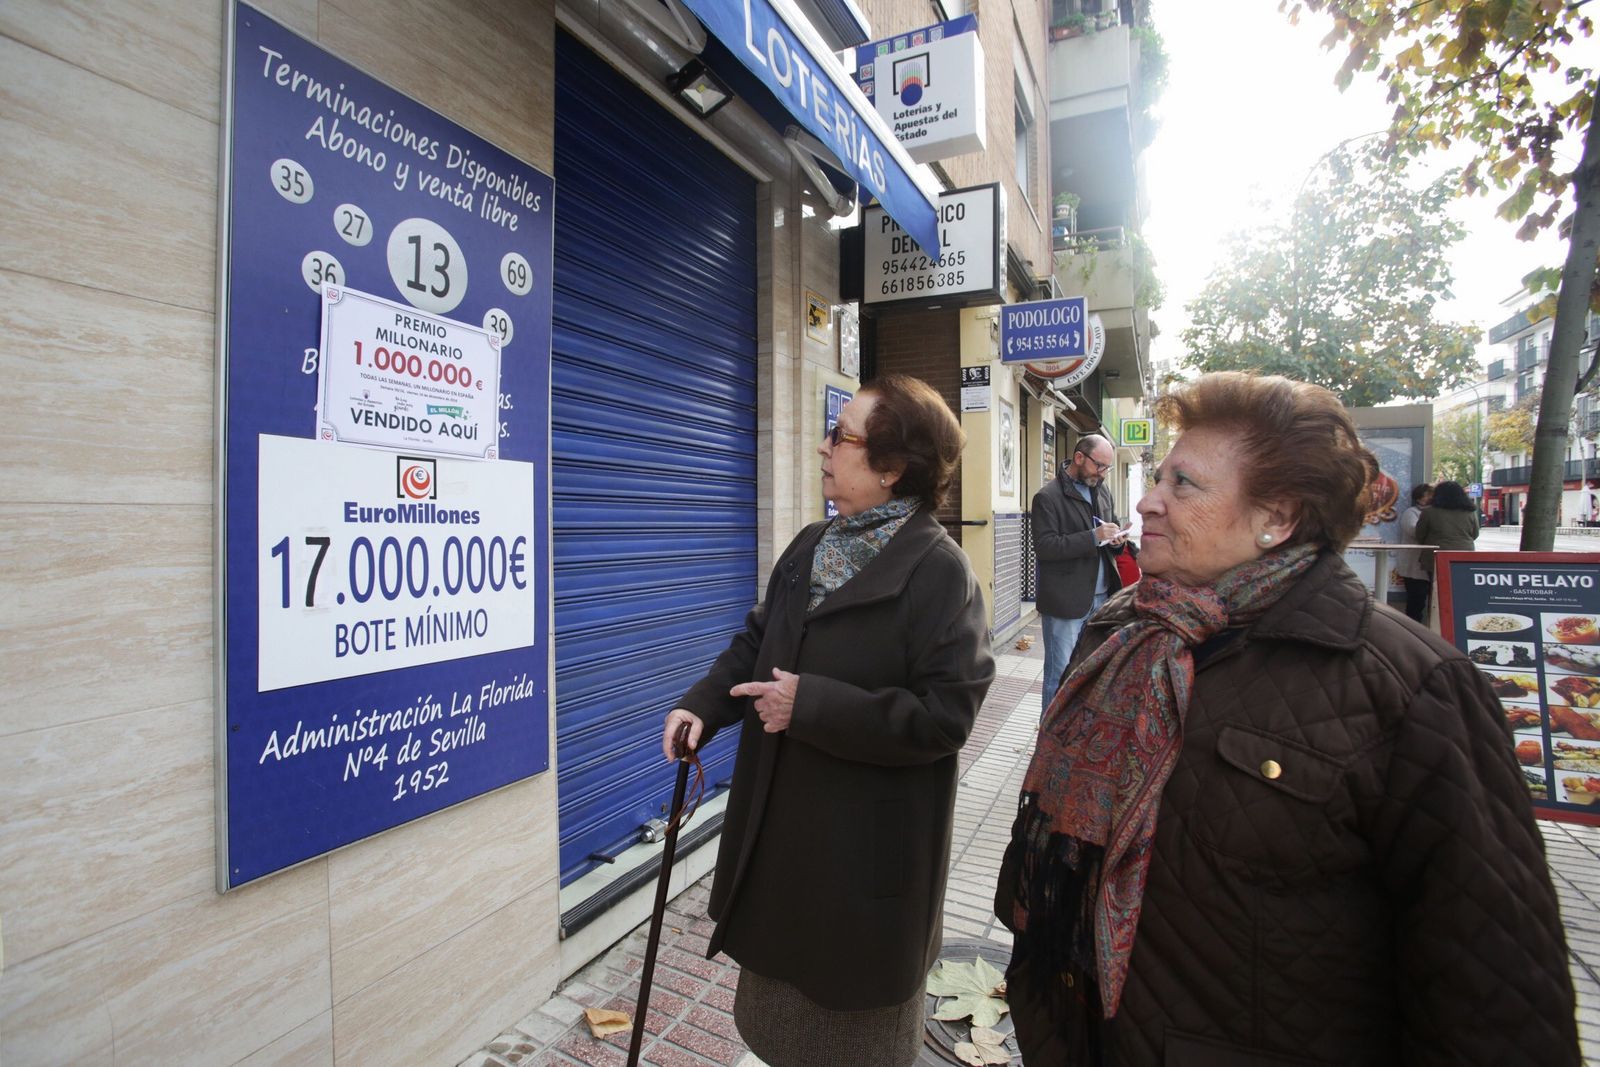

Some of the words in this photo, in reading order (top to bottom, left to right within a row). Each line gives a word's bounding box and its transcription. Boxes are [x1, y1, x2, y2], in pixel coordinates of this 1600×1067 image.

[893, 104, 932, 120] Loterías
[936, 102, 942, 112] y
[894, 115, 939, 132] Apuestas
[942, 108, 958, 120] del
[258, 45, 439, 160] Terminaciones
[446, 145, 541, 212] Disponibles
[280, 166, 305, 197] 35
[305, 116, 386, 172] Abono
[394, 162, 410, 191] y
[418, 171, 472, 213] venta
[481, 192, 518, 232] libre
[342, 210, 365, 239] 27
[892, 229, 951, 255] DENL
[311, 258, 337, 285] 36
[406, 235, 451, 299] 13
[507, 260, 526, 288] 69
[882, 251, 965, 275] 954424665
[882, 271, 964, 294] 661856385
[395, 314, 447, 339] PREMIO
[1008, 306, 1080, 330] PODOLOGO
[375, 327, 463, 361] MILLONARIO
[1016, 337, 1032, 351] 954
[1033, 335, 1044, 350] 53
[1046, 334, 1057, 349] 55
[1059, 333, 1069, 348] 64
[354, 341, 472, 388] 1.000.000
[360, 372, 378, 381] TODAS
[421, 385, 451, 395] MILLONARIO
[457, 391, 475, 400] ESPAÑA
[350, 407, 432, 434] VENDIDO
[438, 422, 478, 441] AQUÍ
[438, 406, 460, 415] MILLÓN
[344, 501, 480, 525] EuroMillones
[271, 535, 527, 609] 17.000.000€
[1474, 573, 1513, 586] DON
[1518, 574, 1594, 589] PELAYO
[335, 618, 396, 658] BOTE
[405, 605, 488, 647] MÍNIMO
[259, 695, 442, 764] Administración
[450, 692, 472, 717] La
[478, 673, 534, 711] Florida
[397, 732, 421, 765] de
[429, 716, 487, 757] Sevilla
[393, 761, 449, 801] 1952
